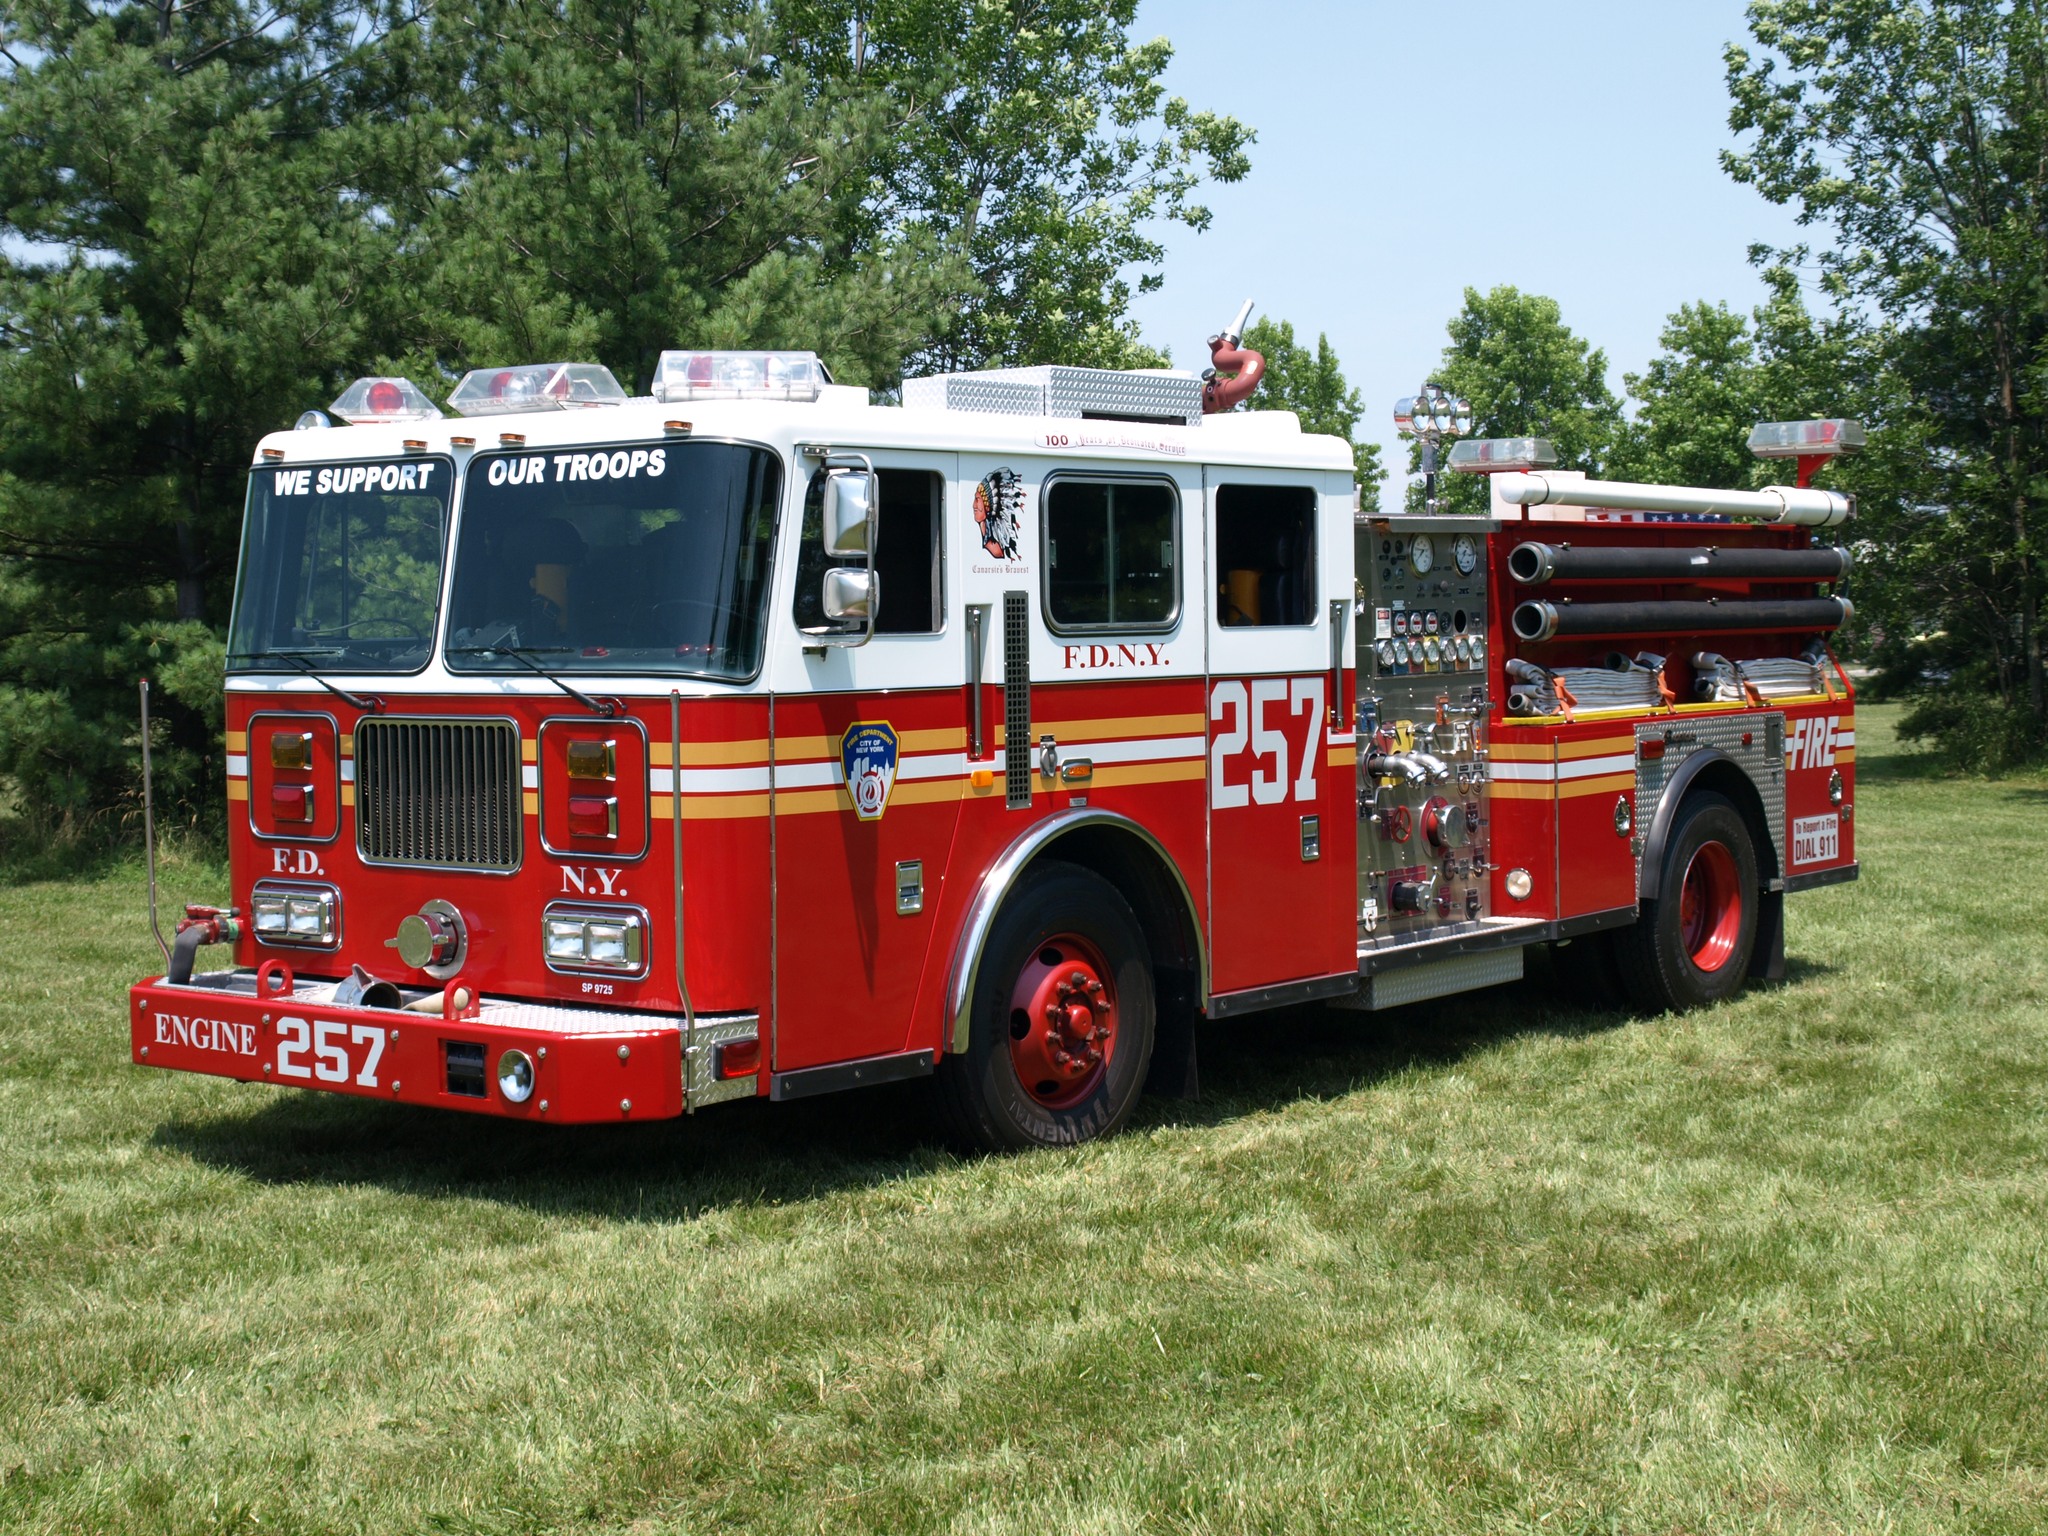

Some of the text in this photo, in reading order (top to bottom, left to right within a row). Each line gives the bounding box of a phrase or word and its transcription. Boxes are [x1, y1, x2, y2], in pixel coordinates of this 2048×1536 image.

[1045, 434, 1069, 446] 100
[275, 463, 434, 496] WE SUPPORT
[488, 449, 666, 486] OUR TROOPS
[1063, 643, 1170, 669] F.D.N.Y.
[847, 729, 893, 748] FIRE DEPARTMENT
[1211, 677, 1324, 810] 257
[1791, 716, 1840, 771] FIRE
[1796, 818, 1836, 834] To Report a Fire
[271, 847, 325, 876] F.D.
[1796, 834, 1836, 861] DIAL 911
[559, 865, 628, 897] N.Y.
[581, 982, 613, 995] SP 9725
[154, 1013, 385, 1088] ENGINE 257
